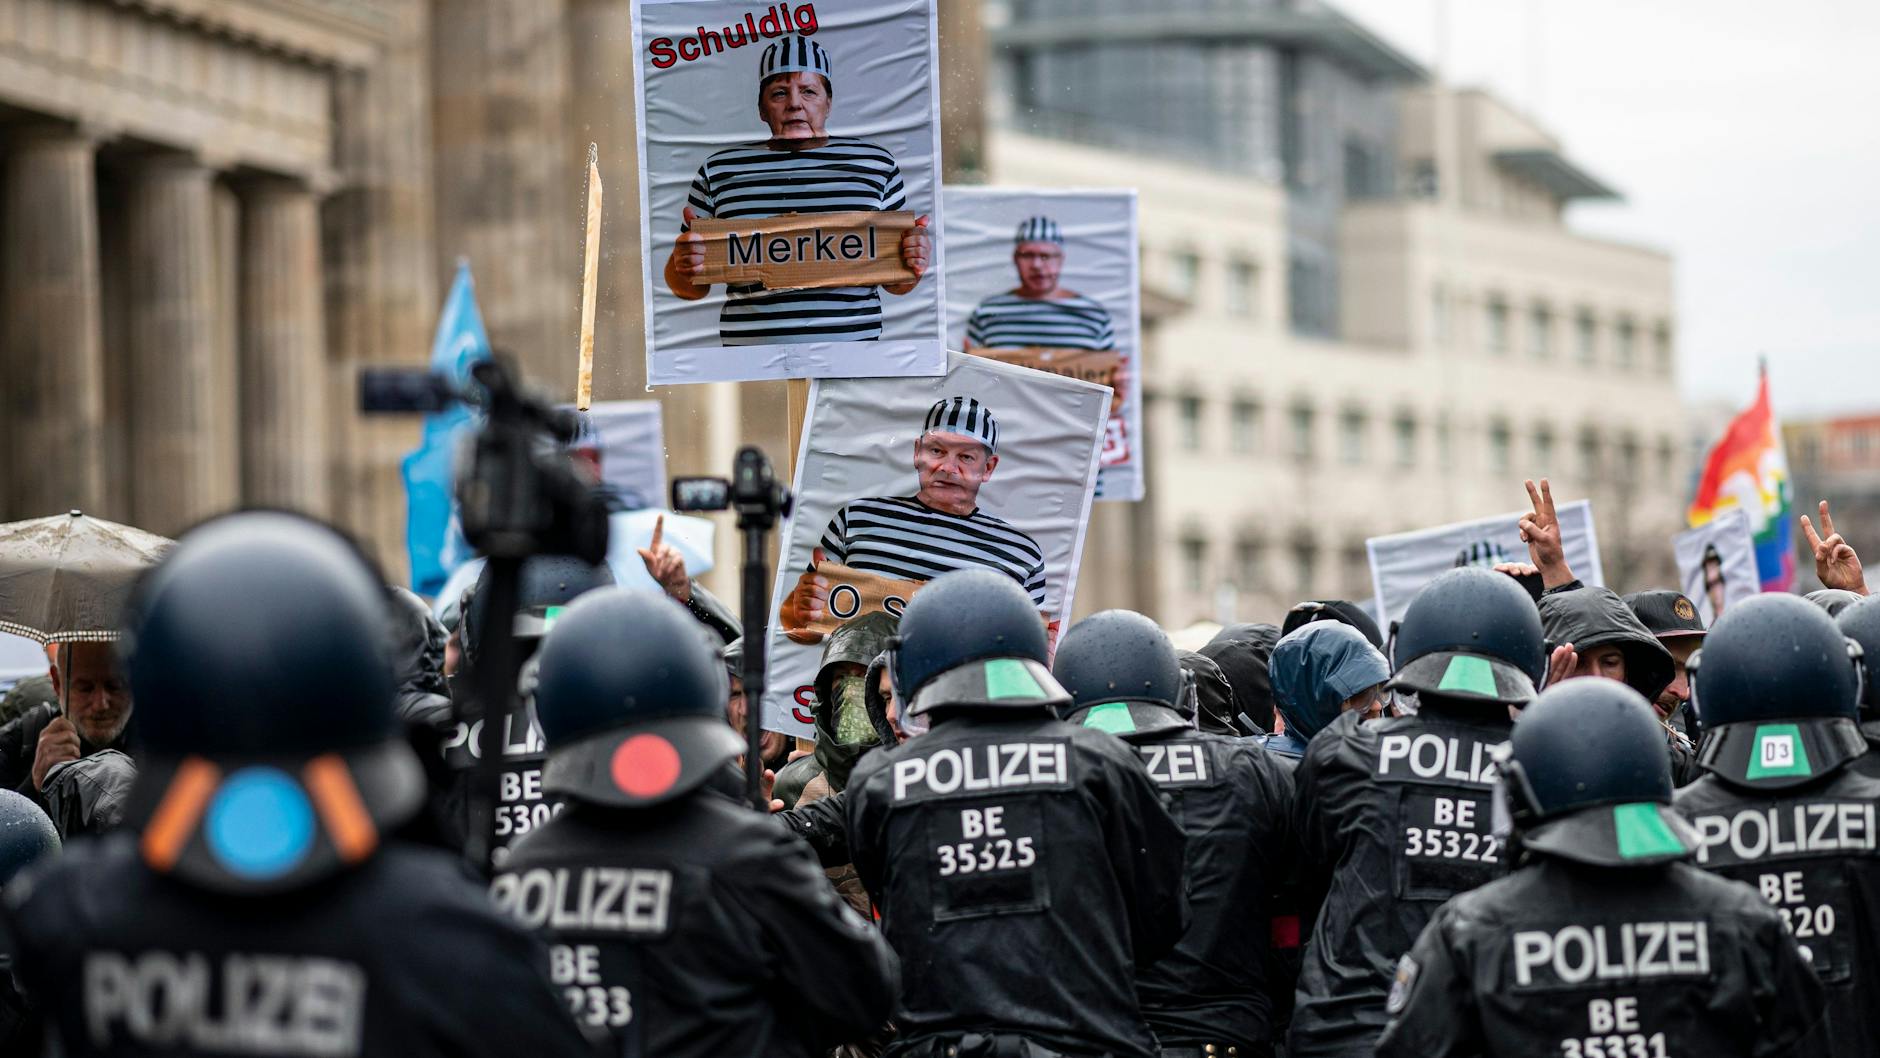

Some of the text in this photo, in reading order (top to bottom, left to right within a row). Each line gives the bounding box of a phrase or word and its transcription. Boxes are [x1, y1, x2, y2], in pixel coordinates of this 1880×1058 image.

[649, 2, 819, 68] Schuldig
[728, 226, 876, 265] Merkel
[894, 743, 1068, 800] POLIZEI
[1140, 744, 1206, 782] ZEI
[1378, 733, 1500, 784] POLIZ
[501, 769, 543, 801] BE
[961, 806, 1006, 839] BE
[1434, 797, 1476, 828] BE
[1405, 827, 1498, 863] 35322
[1695, 803, 1876, 863] POLIZEI
[936, 836, 1037, 876] 35325
[490, 867, 672, 934] POLIZEI
[1759, 871, 1805, 904] BE
[551, 944, 601, 984] BE
[1513, 921, 1710, 986] POLIZEI
[85, 952, 365, 1058] POLIZEI
[1588, 997, 1640, 1034] BE
[1560, 1031, 1671, 1058] 35331
